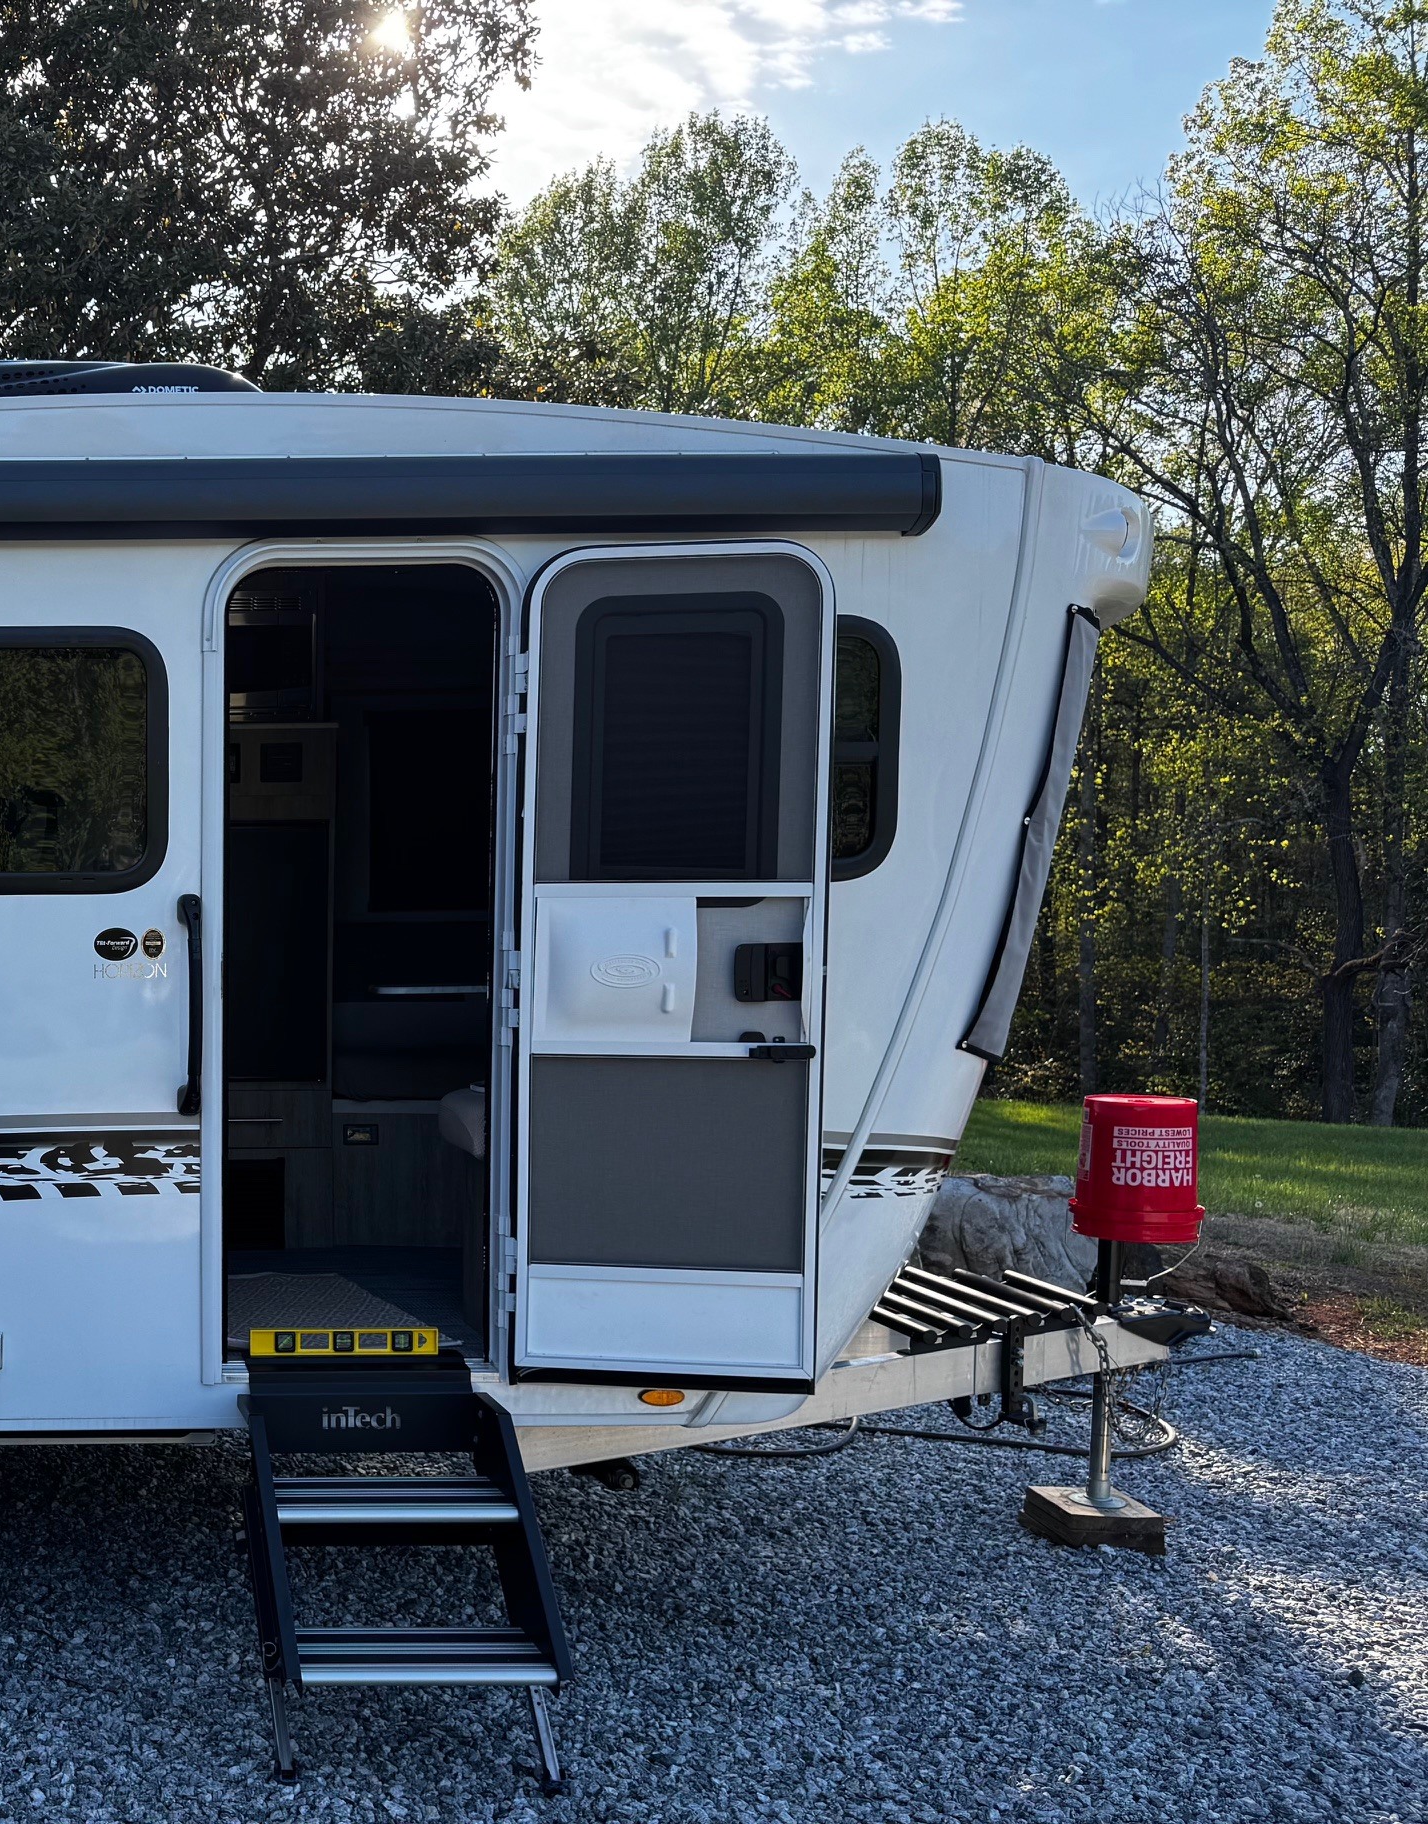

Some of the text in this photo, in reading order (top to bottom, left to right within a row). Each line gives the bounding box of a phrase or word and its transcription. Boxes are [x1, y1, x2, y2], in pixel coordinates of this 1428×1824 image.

[1117, 1128, 1190, 1137] LOWEST PRICES
[1117, 1140, 1151, 1148] TOOLS
[1111, 1150, 1192, 1169] FREIGHT
[1112, 1167, 1192, 1187] HARBOR
[322, 1406, 401, 1429] inTech
